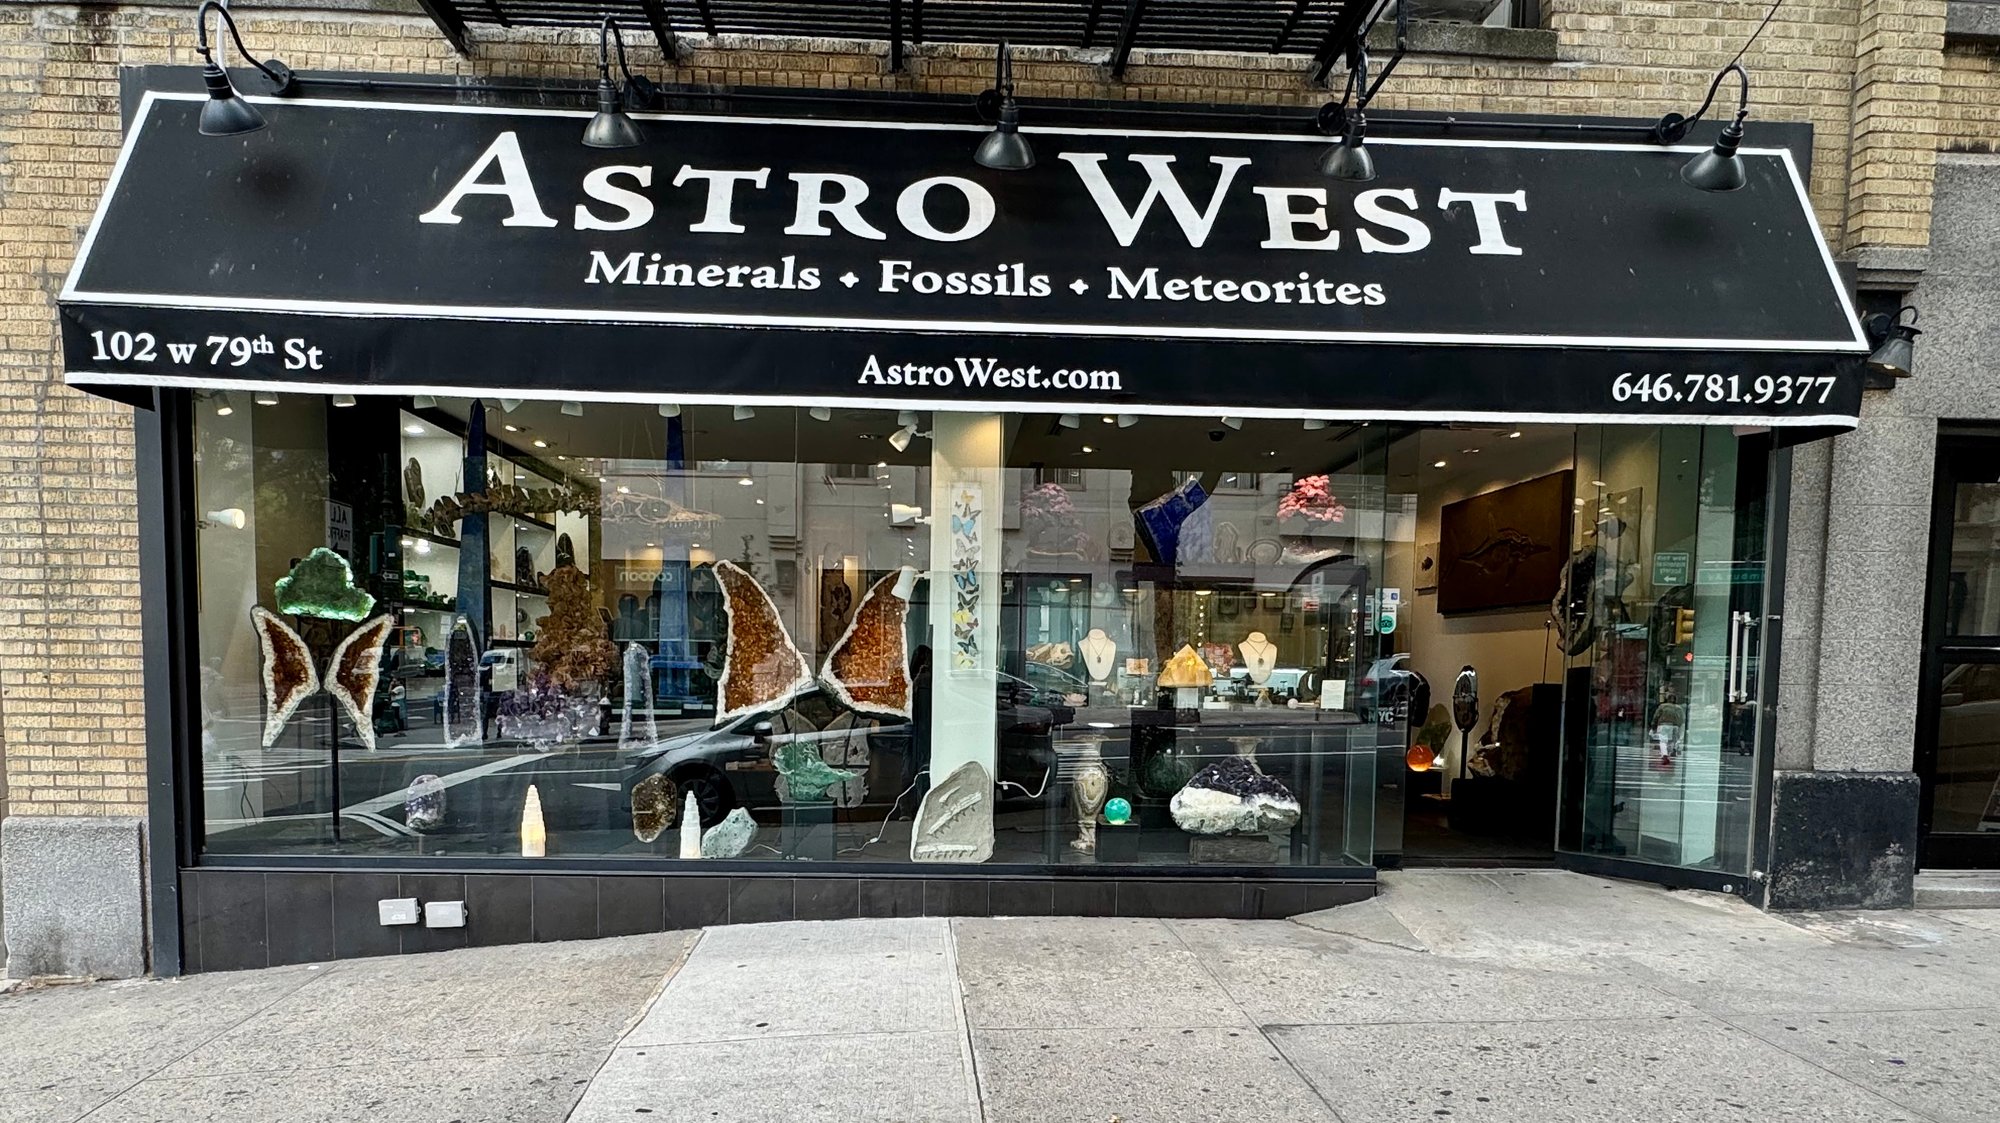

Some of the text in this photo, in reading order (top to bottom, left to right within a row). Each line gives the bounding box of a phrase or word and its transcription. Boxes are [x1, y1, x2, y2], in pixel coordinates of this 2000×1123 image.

[419, 131, 1528, 256] ASTRO WEST
[584, 250, 1387, 306] Minerals Fossils Meteorites
[90, 330, 324, 372] 102 w 79th St
[857, 354, 1123, 390] AstroWest.com
[1612, 372, 1837, 406] 646.781.9377
[1368, 711, 1394, 722] NYC
